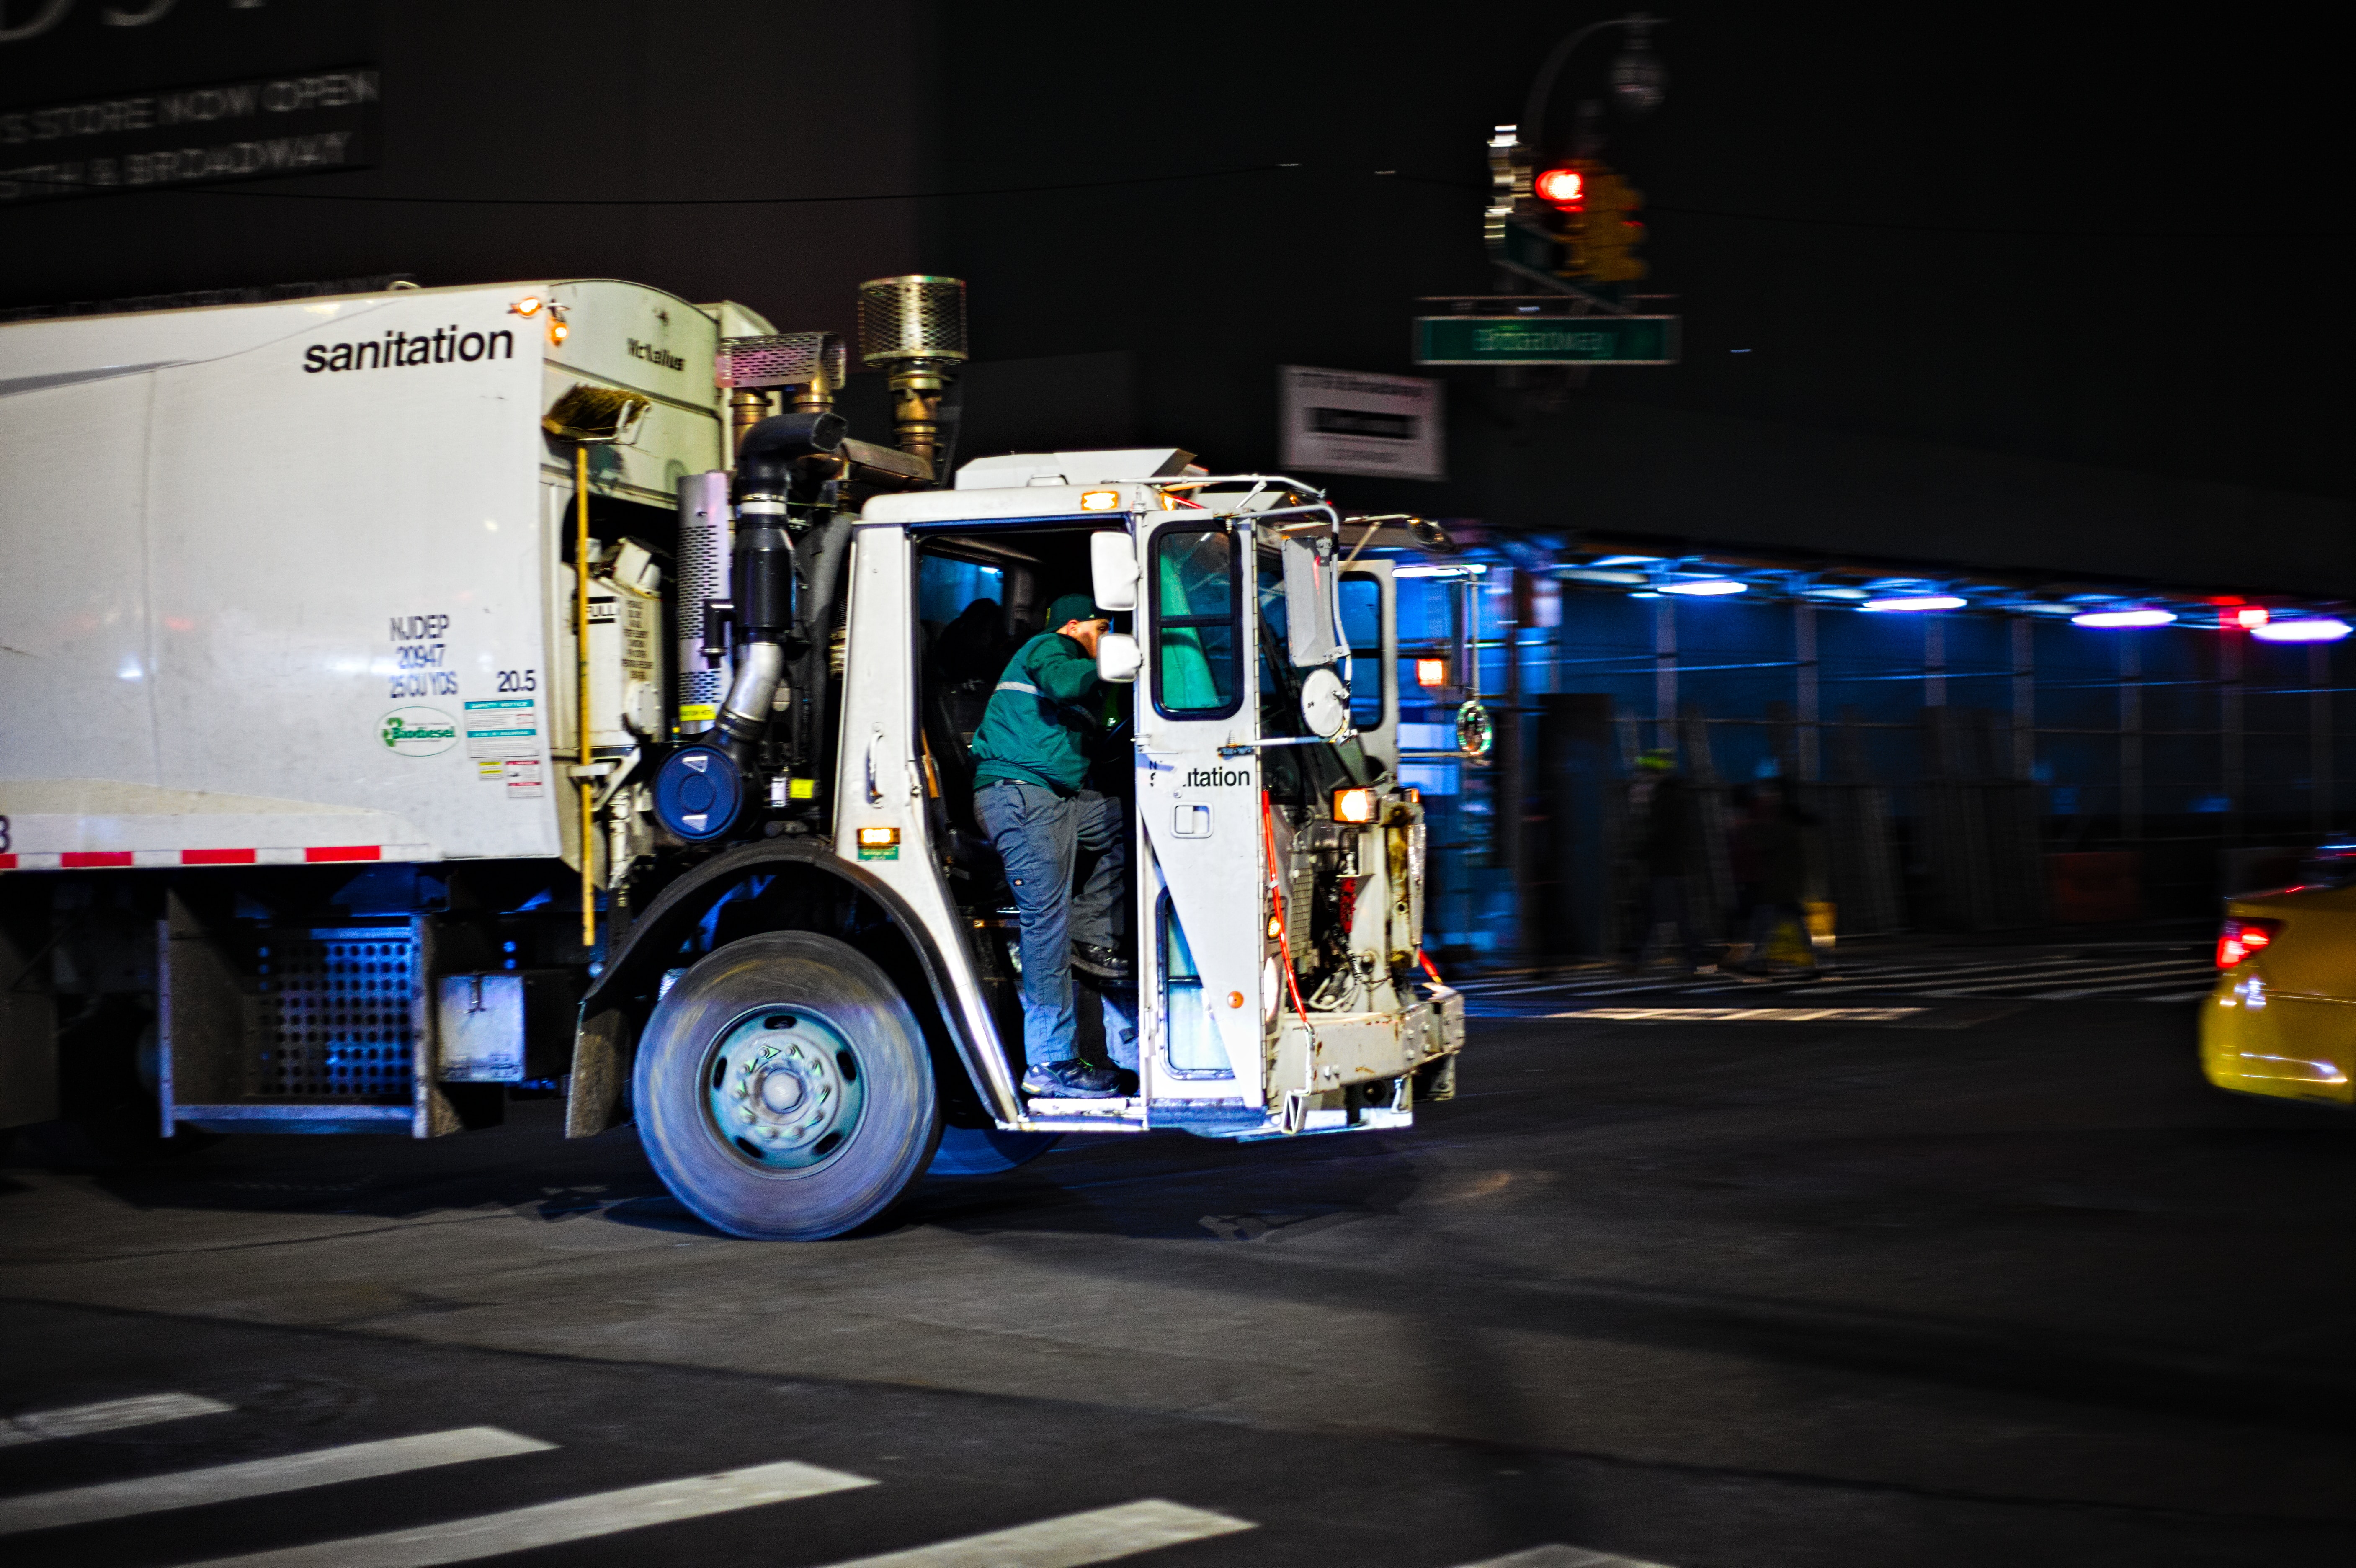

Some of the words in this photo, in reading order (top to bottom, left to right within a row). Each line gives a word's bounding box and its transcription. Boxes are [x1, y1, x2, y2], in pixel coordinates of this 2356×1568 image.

[32, 96, 157, 140] STORE
[157, 85, 260, 125] NOW
[261, 71, 380, 112] OPEN
[121, 132, 353, 185] BROADWAY
[303, 324, 513, 373] sanitation
[389, 614, 449, 641] NJDEP
[395, 644, 446, 669] 20947
[429, 671, 459, 695] YDS
[497, 670, 536, 693] 20.5
[1150, 766, 1250, 787] itation
